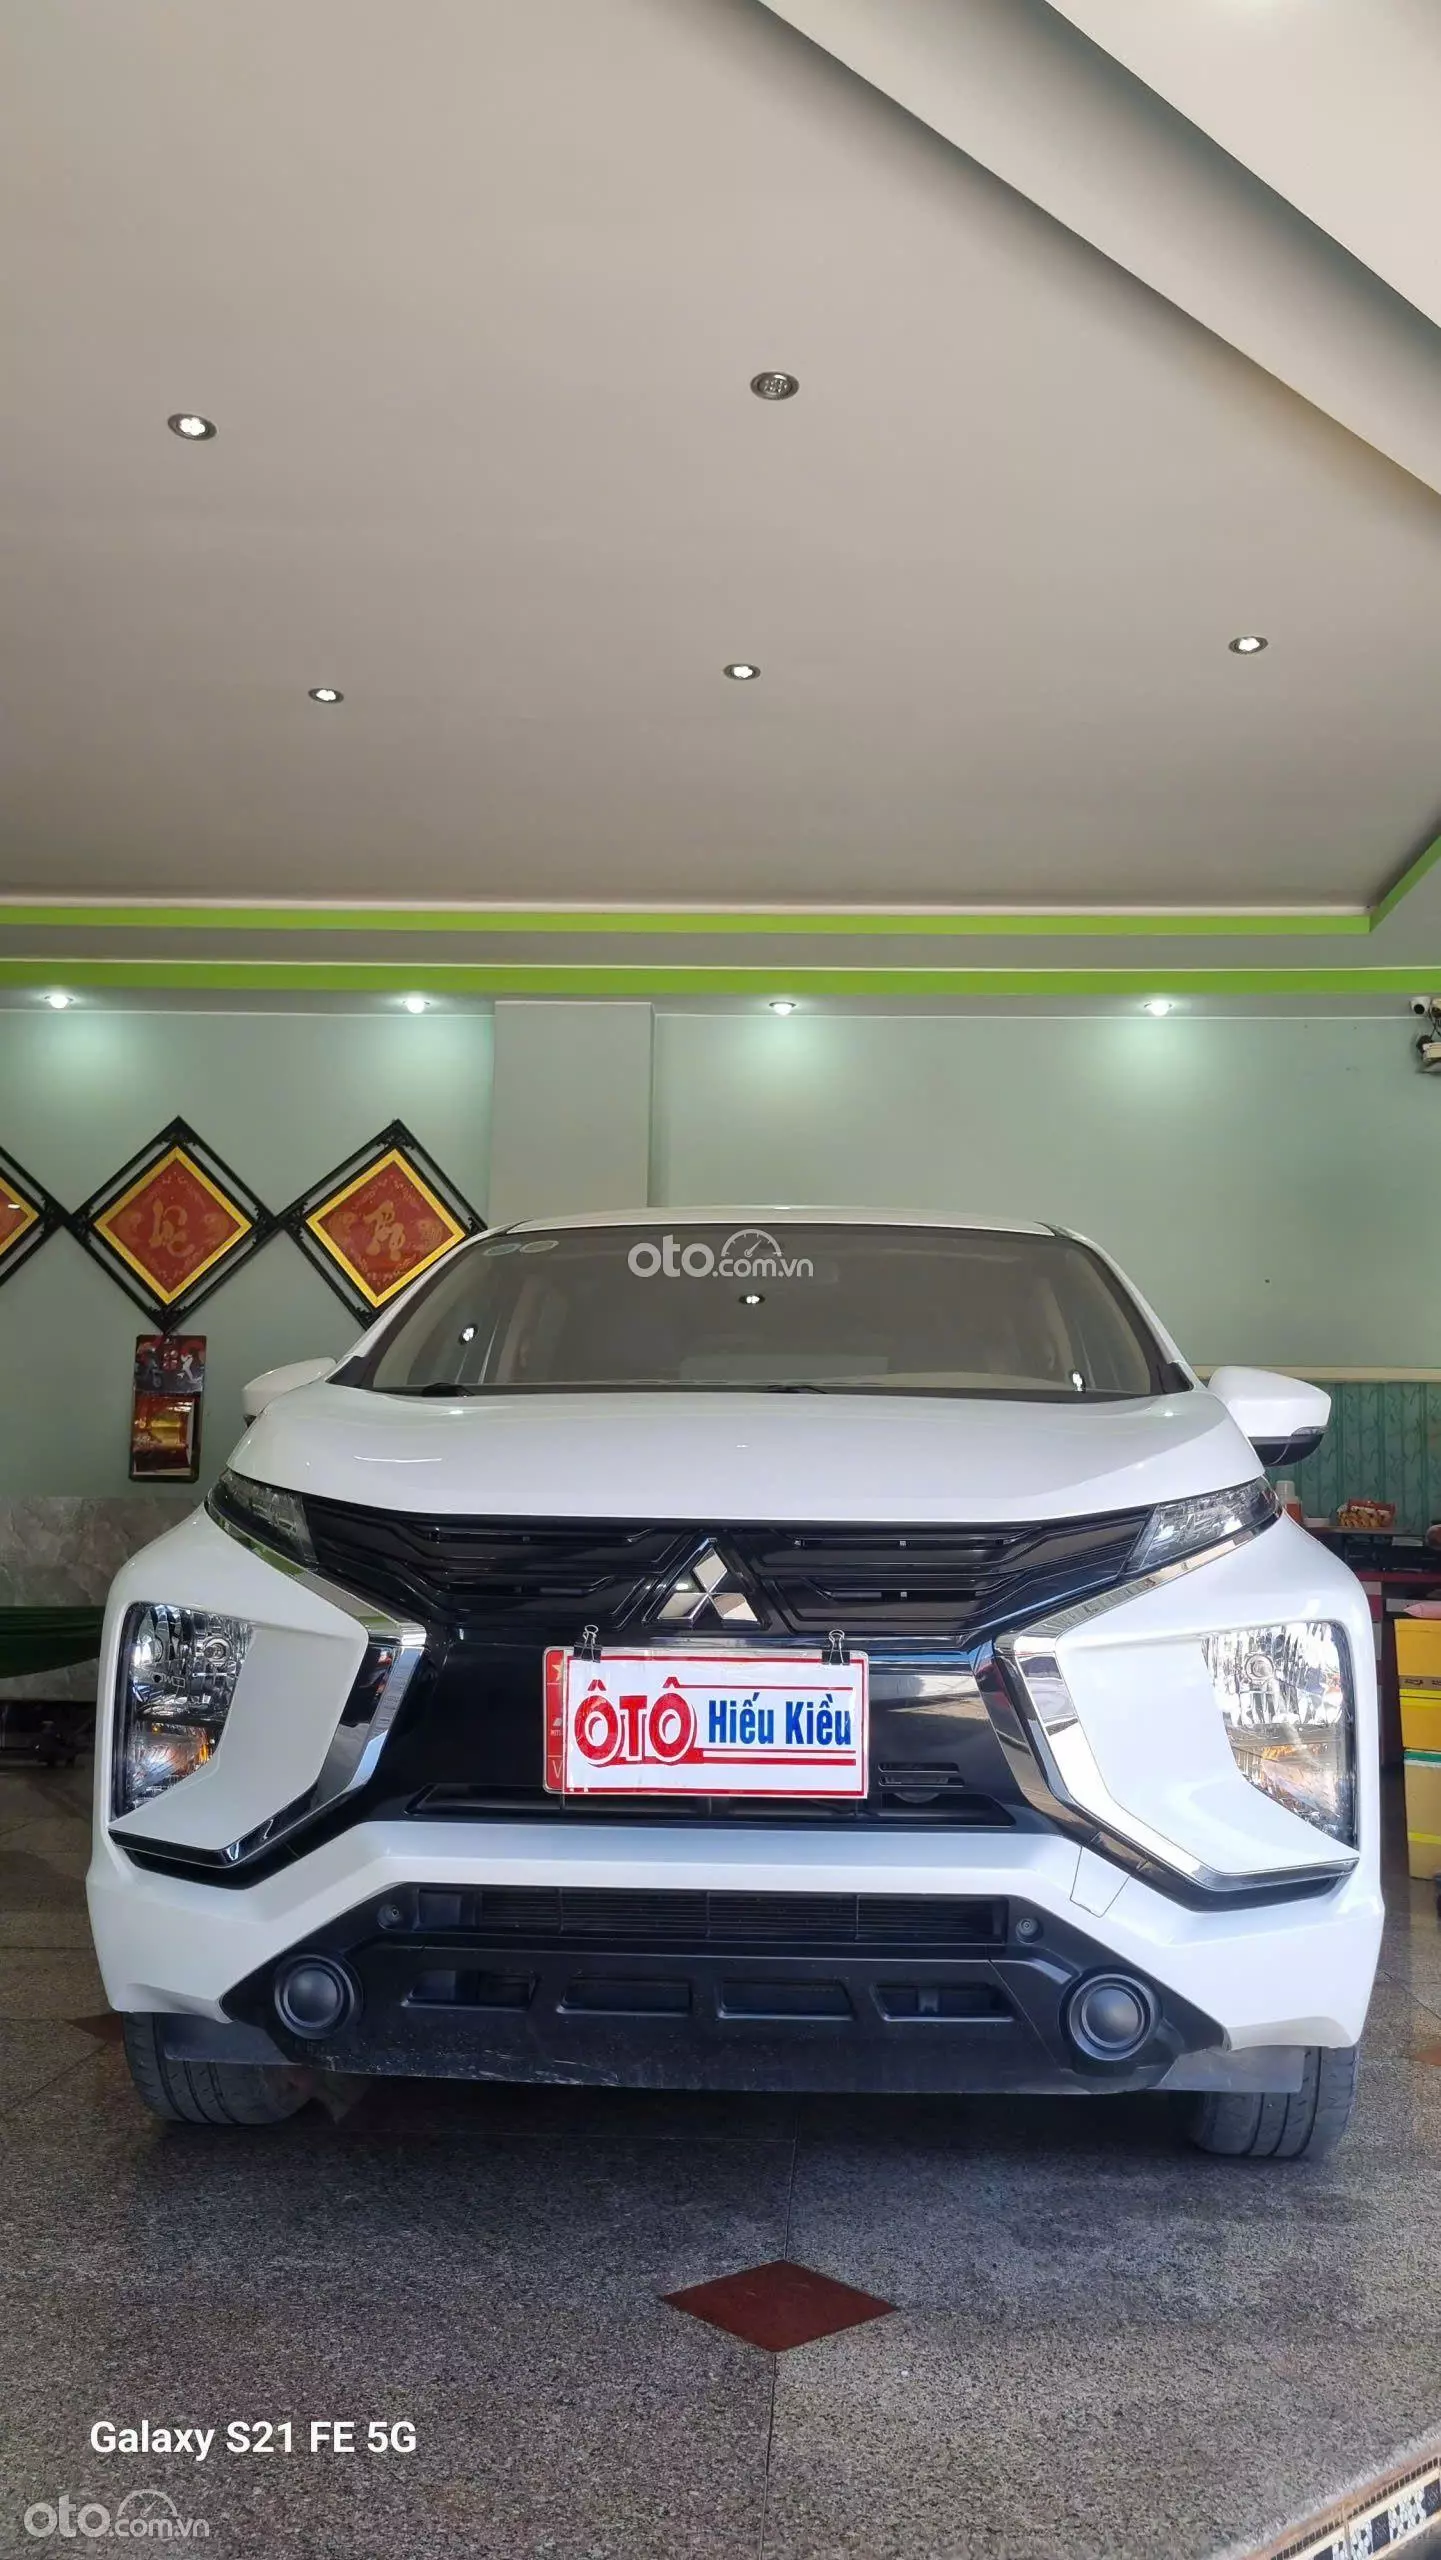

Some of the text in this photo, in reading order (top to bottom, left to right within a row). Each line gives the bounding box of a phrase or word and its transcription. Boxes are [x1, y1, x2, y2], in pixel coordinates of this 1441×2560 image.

[573, 1677, 852, 1764] ÔTÔ Hiếu Kiều
